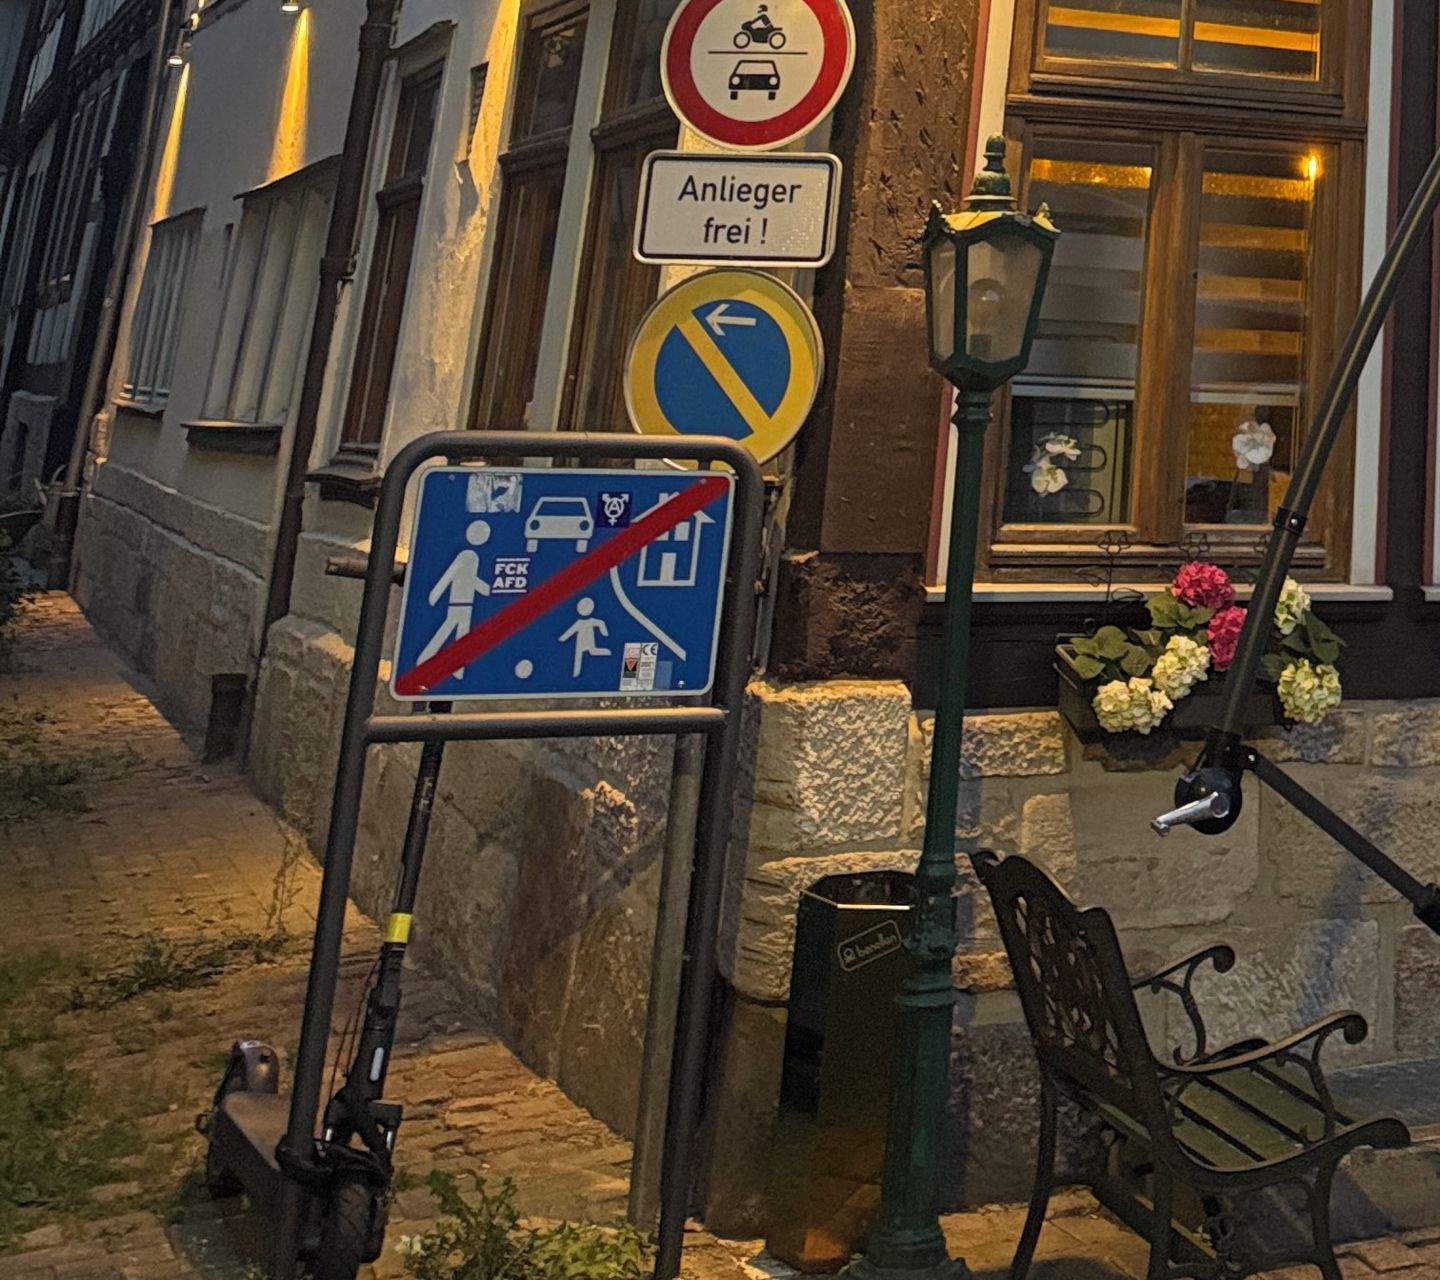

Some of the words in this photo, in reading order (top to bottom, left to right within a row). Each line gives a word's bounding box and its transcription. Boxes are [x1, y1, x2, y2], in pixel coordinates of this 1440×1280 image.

[677, 174, 802, 210] Anlieger
[493, 562, 530, 576] FCK
[492, 576, 528, 589] AFD
